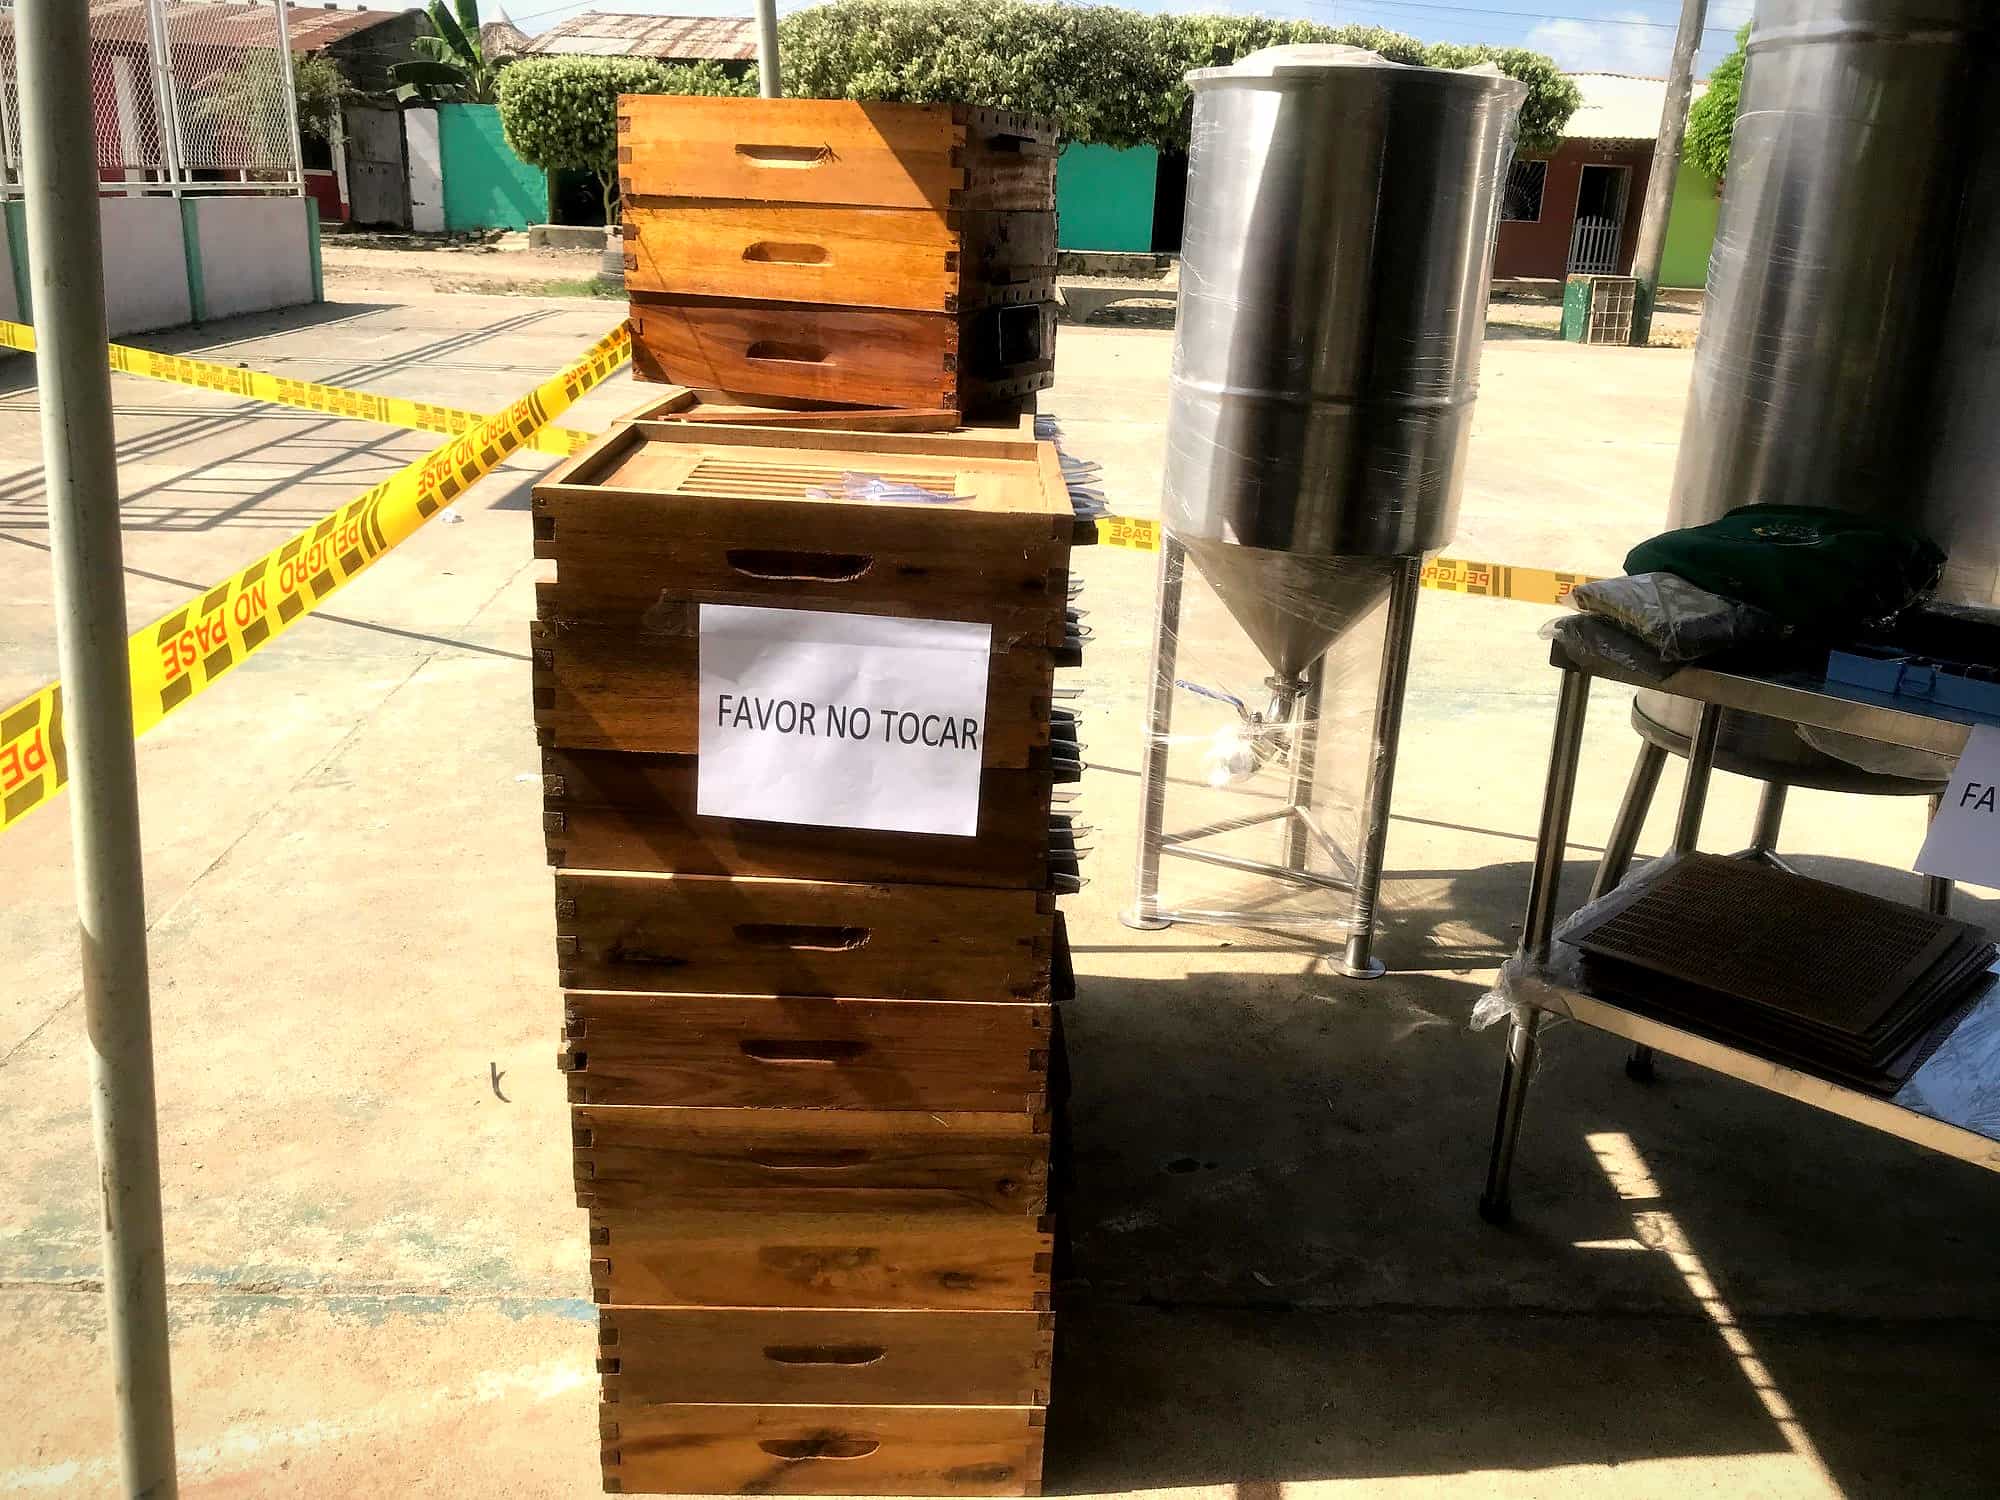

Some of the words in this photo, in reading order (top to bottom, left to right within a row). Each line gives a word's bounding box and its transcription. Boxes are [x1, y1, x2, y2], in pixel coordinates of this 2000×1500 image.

[455, 440, 474, 466] NO
[279, 517, 361, 594] PELIGRO
[234, 580, 268, 627] NO
[161, 607, 228, 681] PASE
[718, 694, 816, 736] FAVOR
[826, 705, 871, 741] NO
[880, 708, 978, 750] TOCAR
